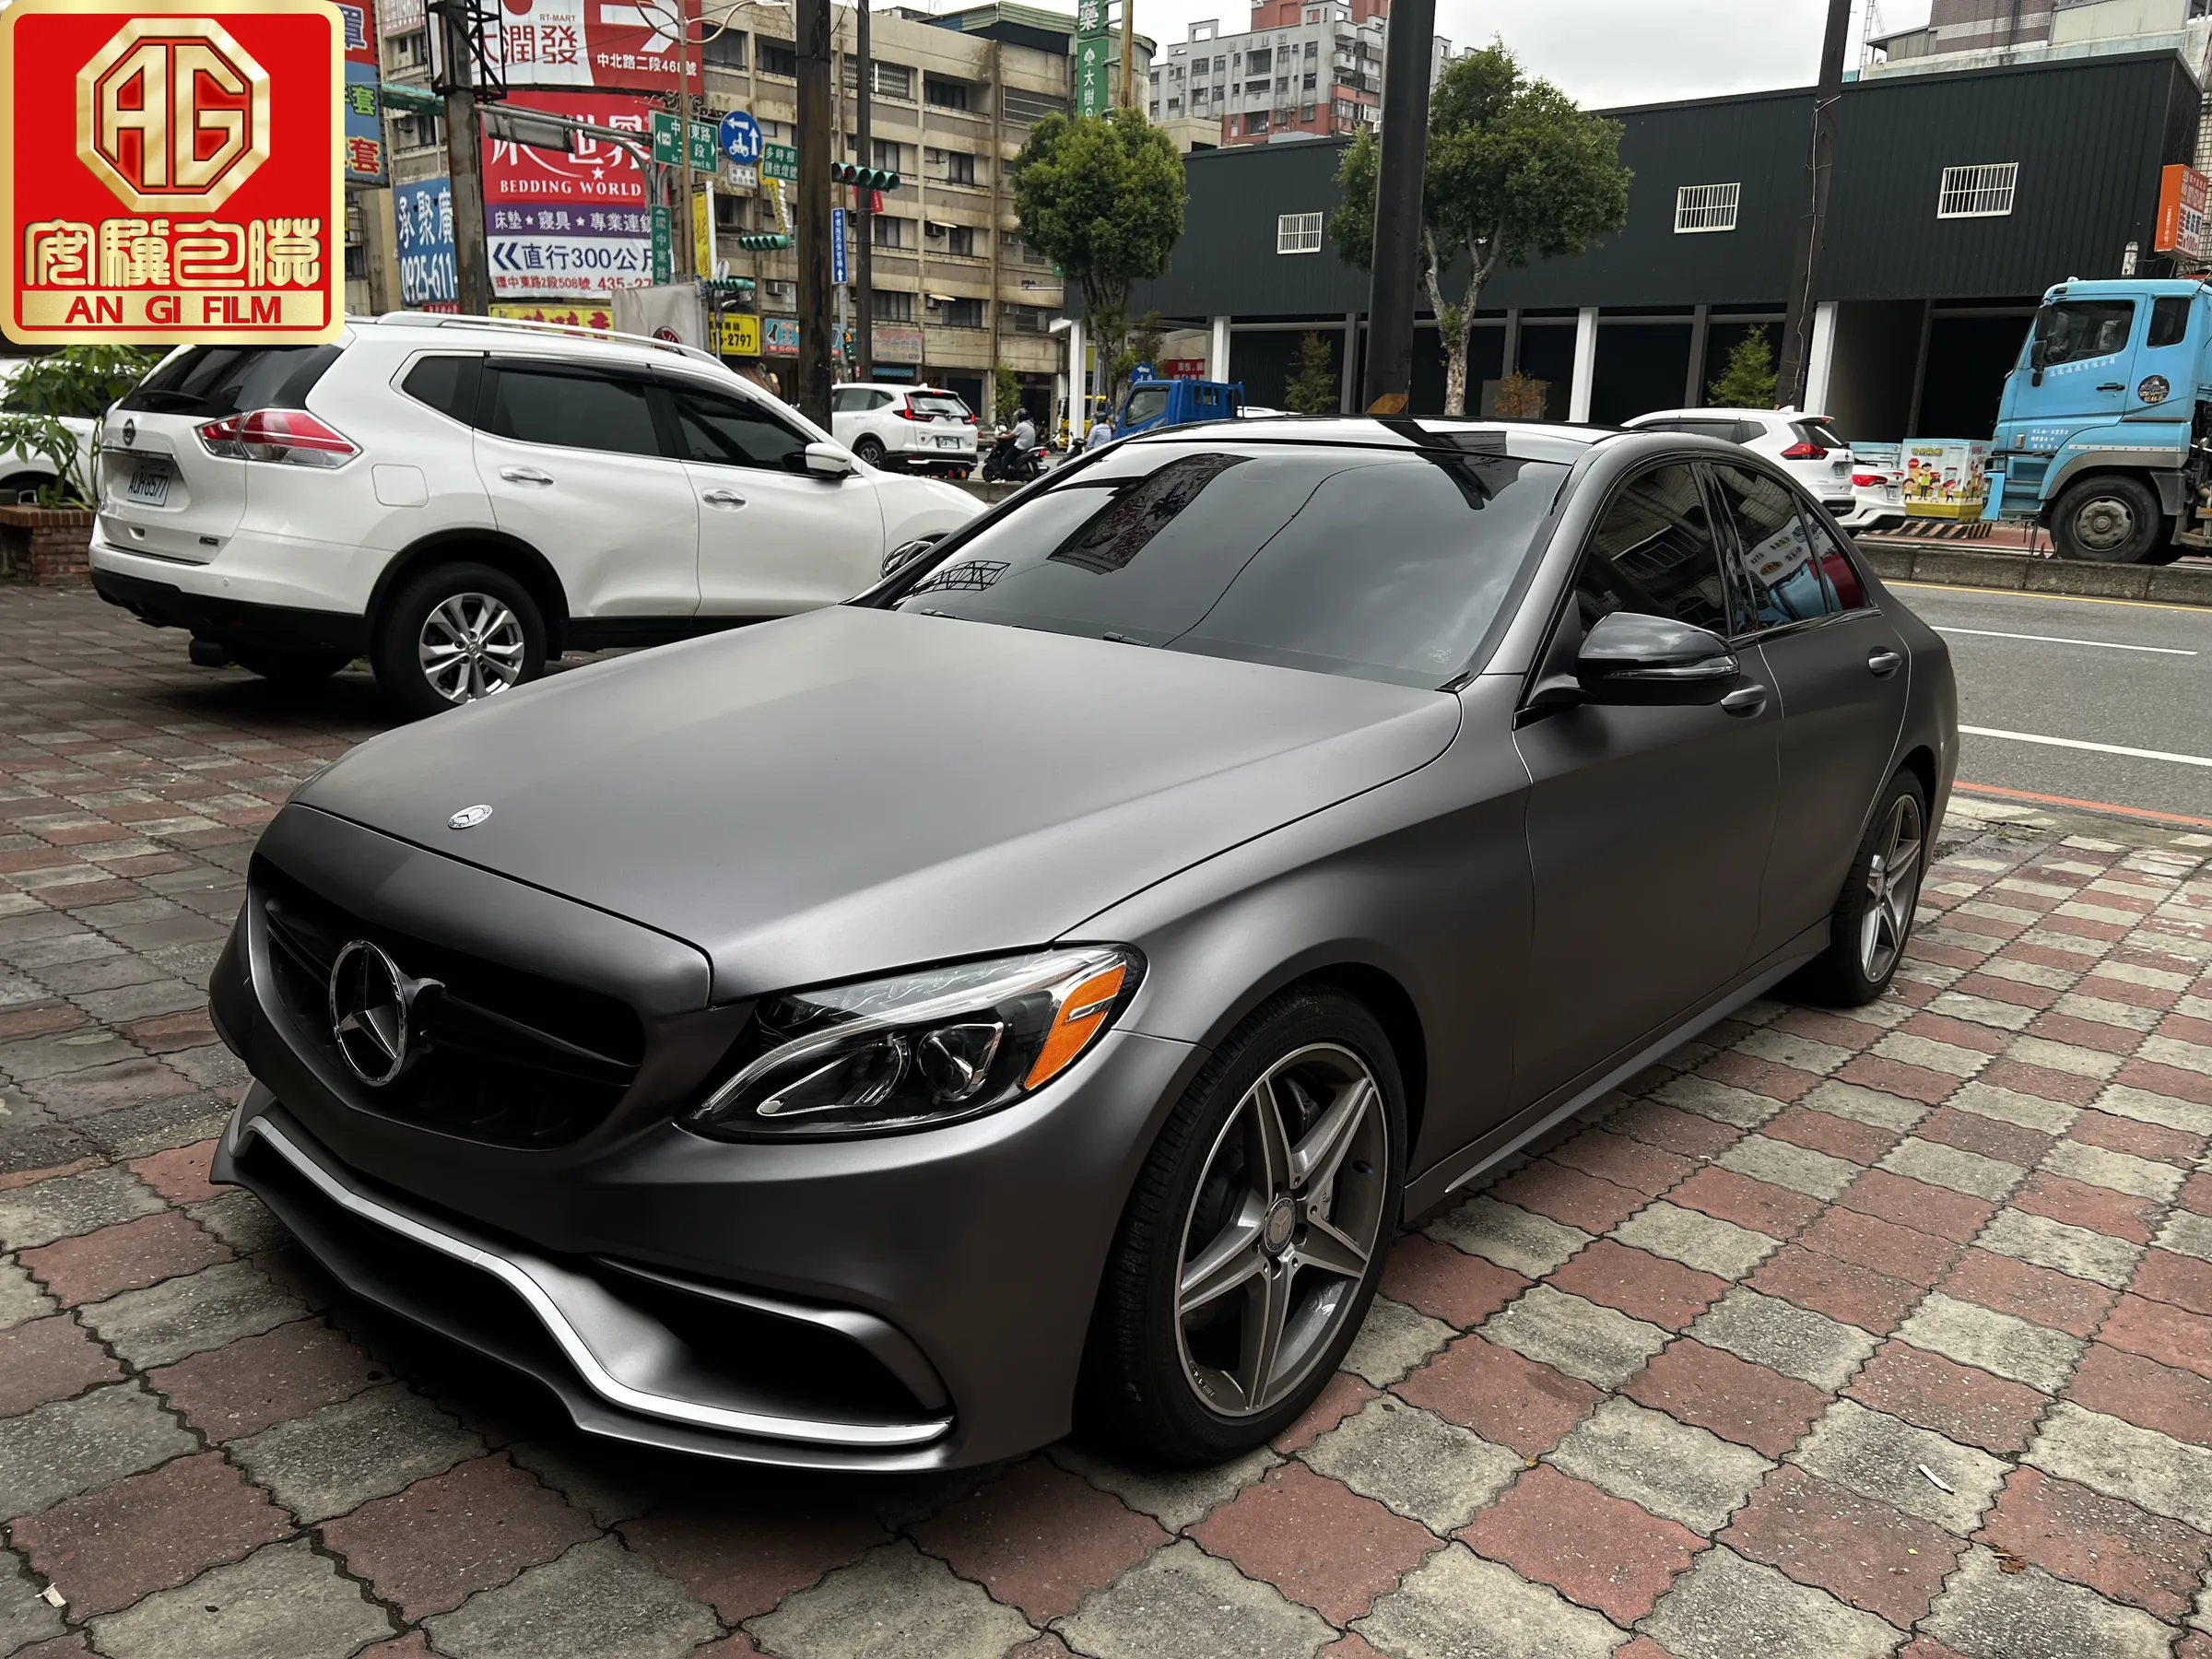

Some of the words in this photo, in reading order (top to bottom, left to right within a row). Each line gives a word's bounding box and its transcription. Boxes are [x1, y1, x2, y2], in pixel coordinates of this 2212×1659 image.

[471, 24, 578, 65] 大潤發
[670, 119, 712, 143] 中東路
[500, 180, 572, 194] BEDDING
[580, 181, 641, 196] WORLD
